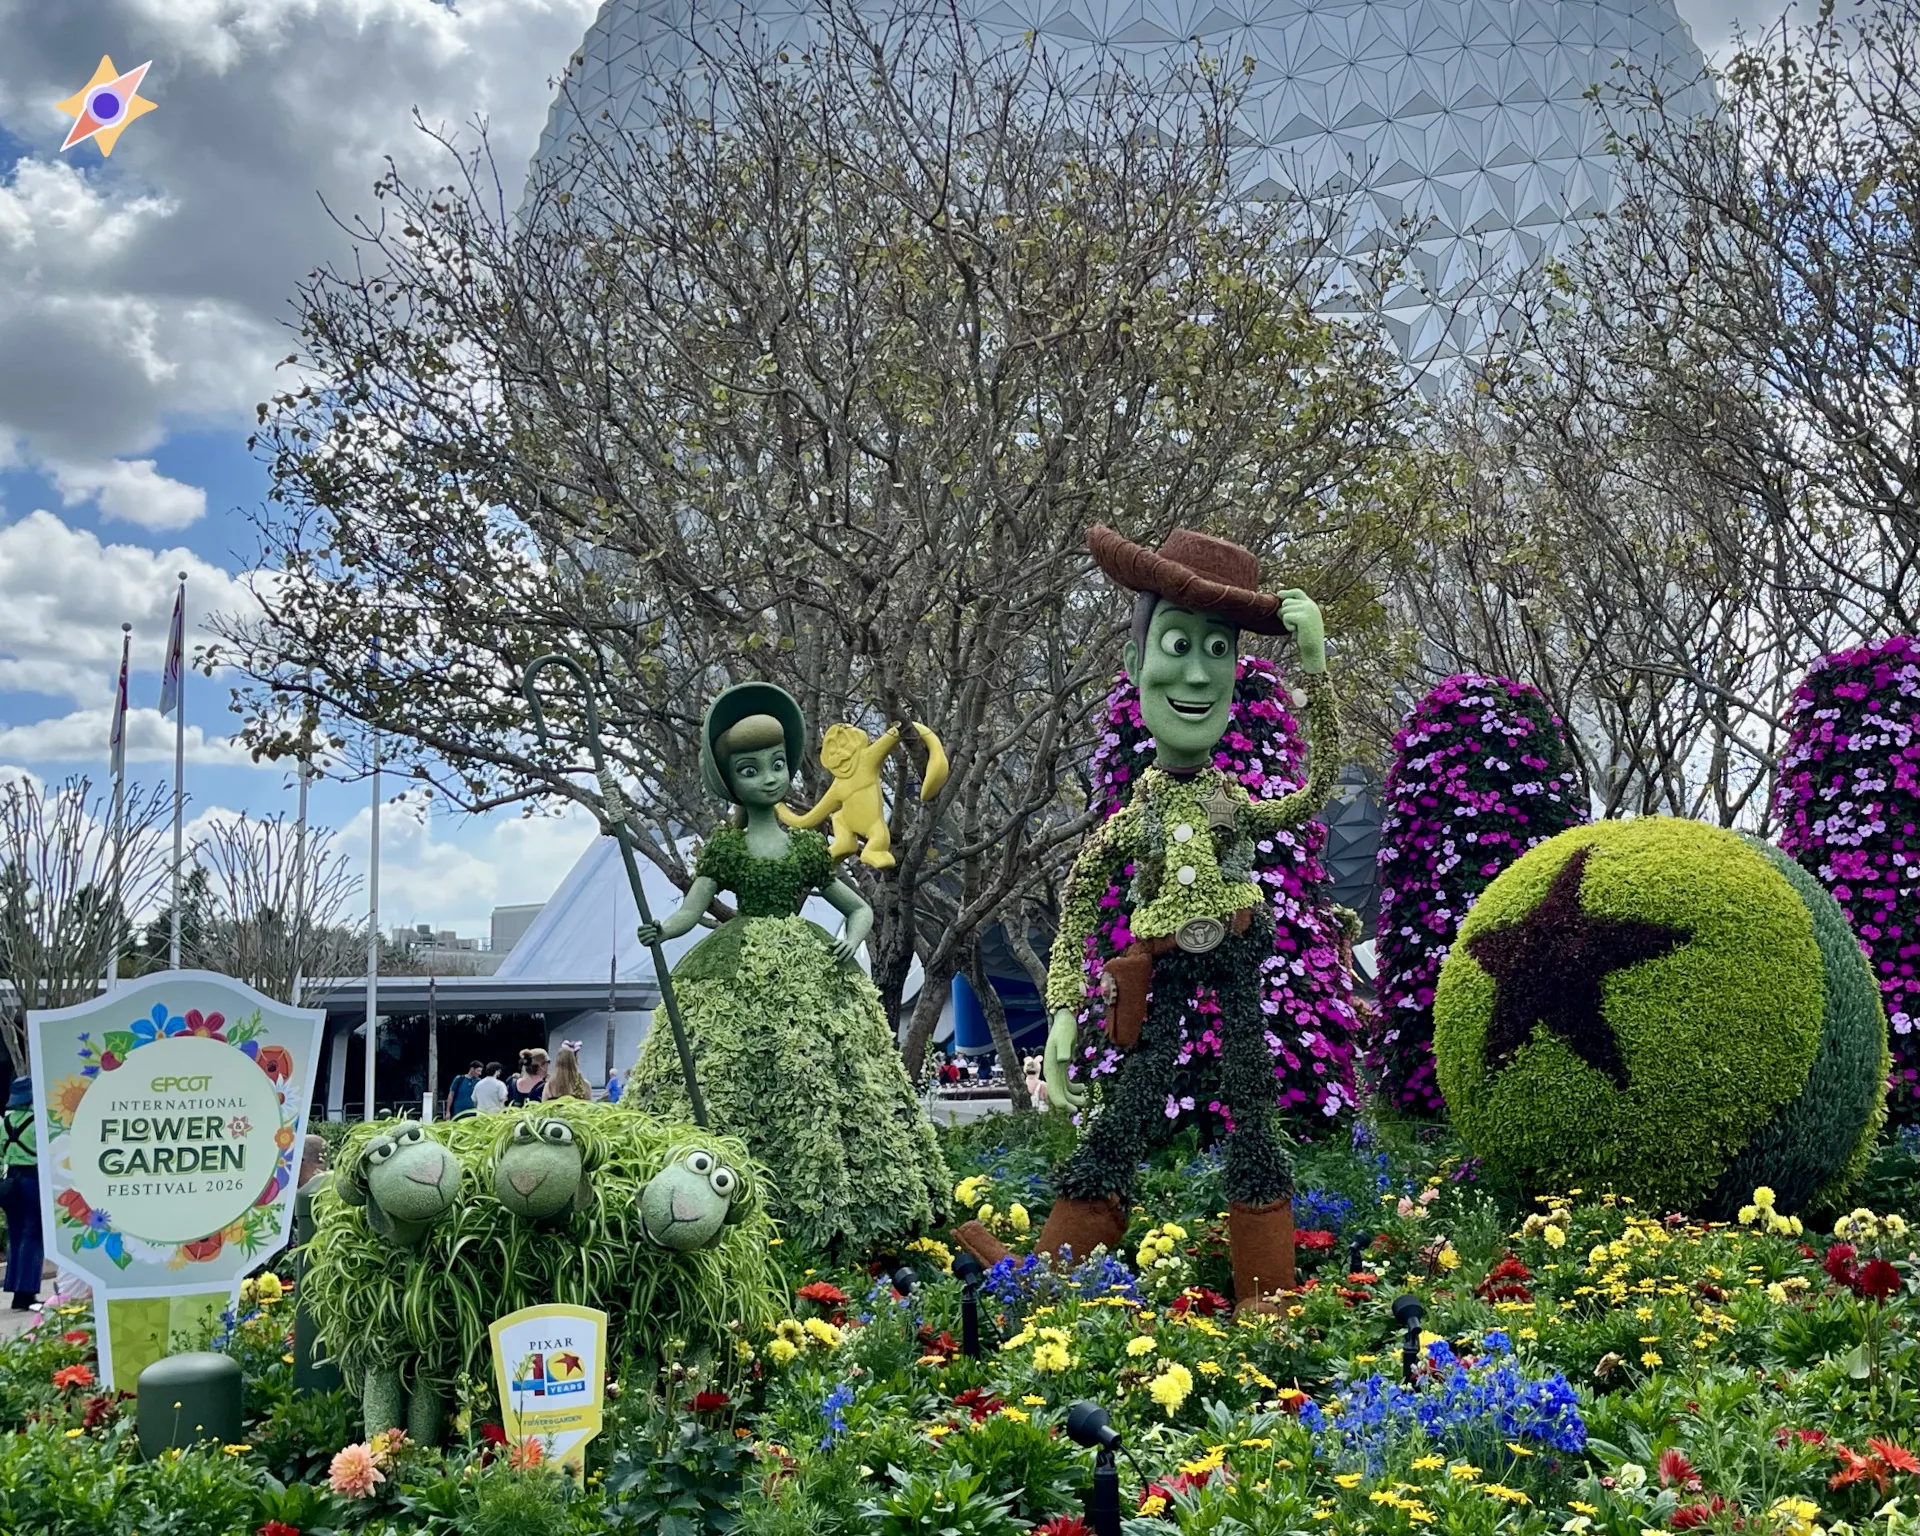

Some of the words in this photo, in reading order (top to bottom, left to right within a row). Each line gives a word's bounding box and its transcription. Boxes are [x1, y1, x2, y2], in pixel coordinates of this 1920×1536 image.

[151, 1076, 212, 1092] EPCOT
[111, 1098, 247, 1111] INTERNATIONAL
[100, 1116, 225, 1143] FLOWER
[98, 1144, 246, 1176] GARDEN
[107, 1182, 197, 1196] FESTIVAL
[206, 1179, 243, 1192] 2026
[529, 1338, 573, 1350] PIXAR
[550, 1383, 582, 1393] YEARS
